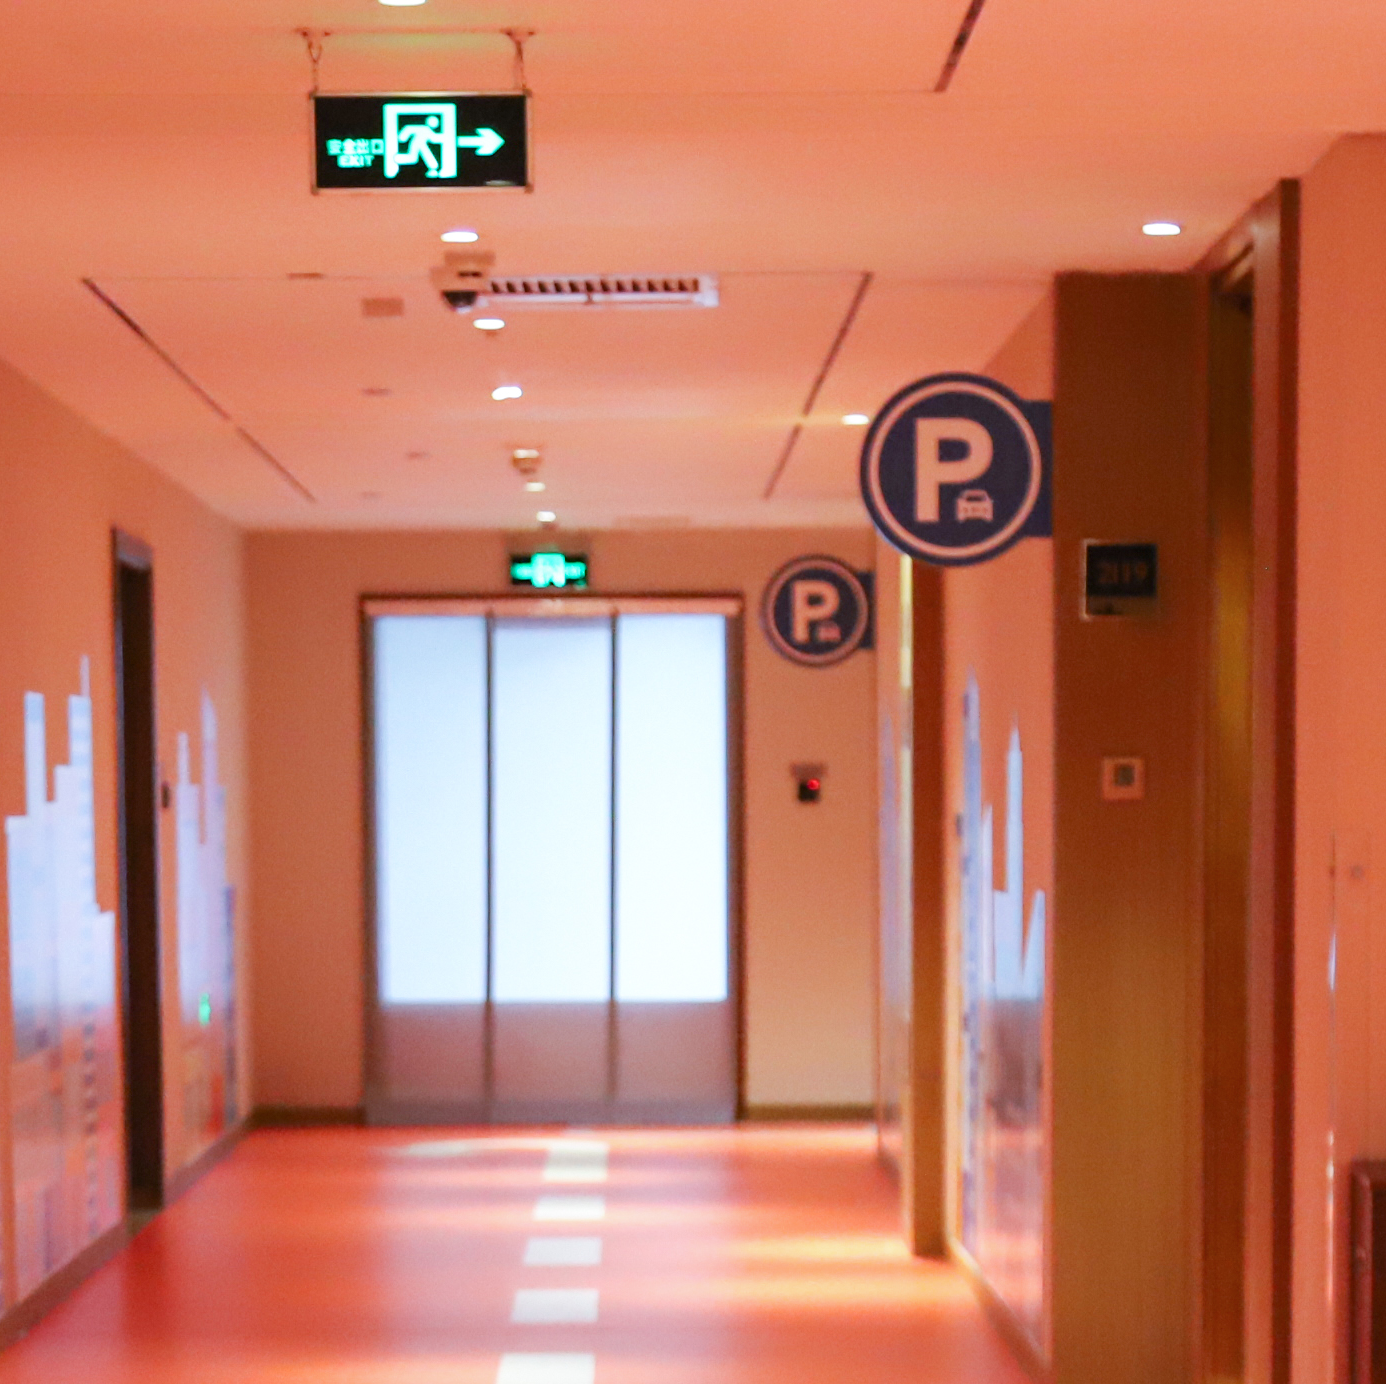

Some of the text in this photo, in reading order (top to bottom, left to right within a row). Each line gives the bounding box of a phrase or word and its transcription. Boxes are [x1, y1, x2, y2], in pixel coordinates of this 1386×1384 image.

[337, 155, 375, 168] EXIT
[914, 417, 993, 523] P
[791, 578, 841, 645] P
